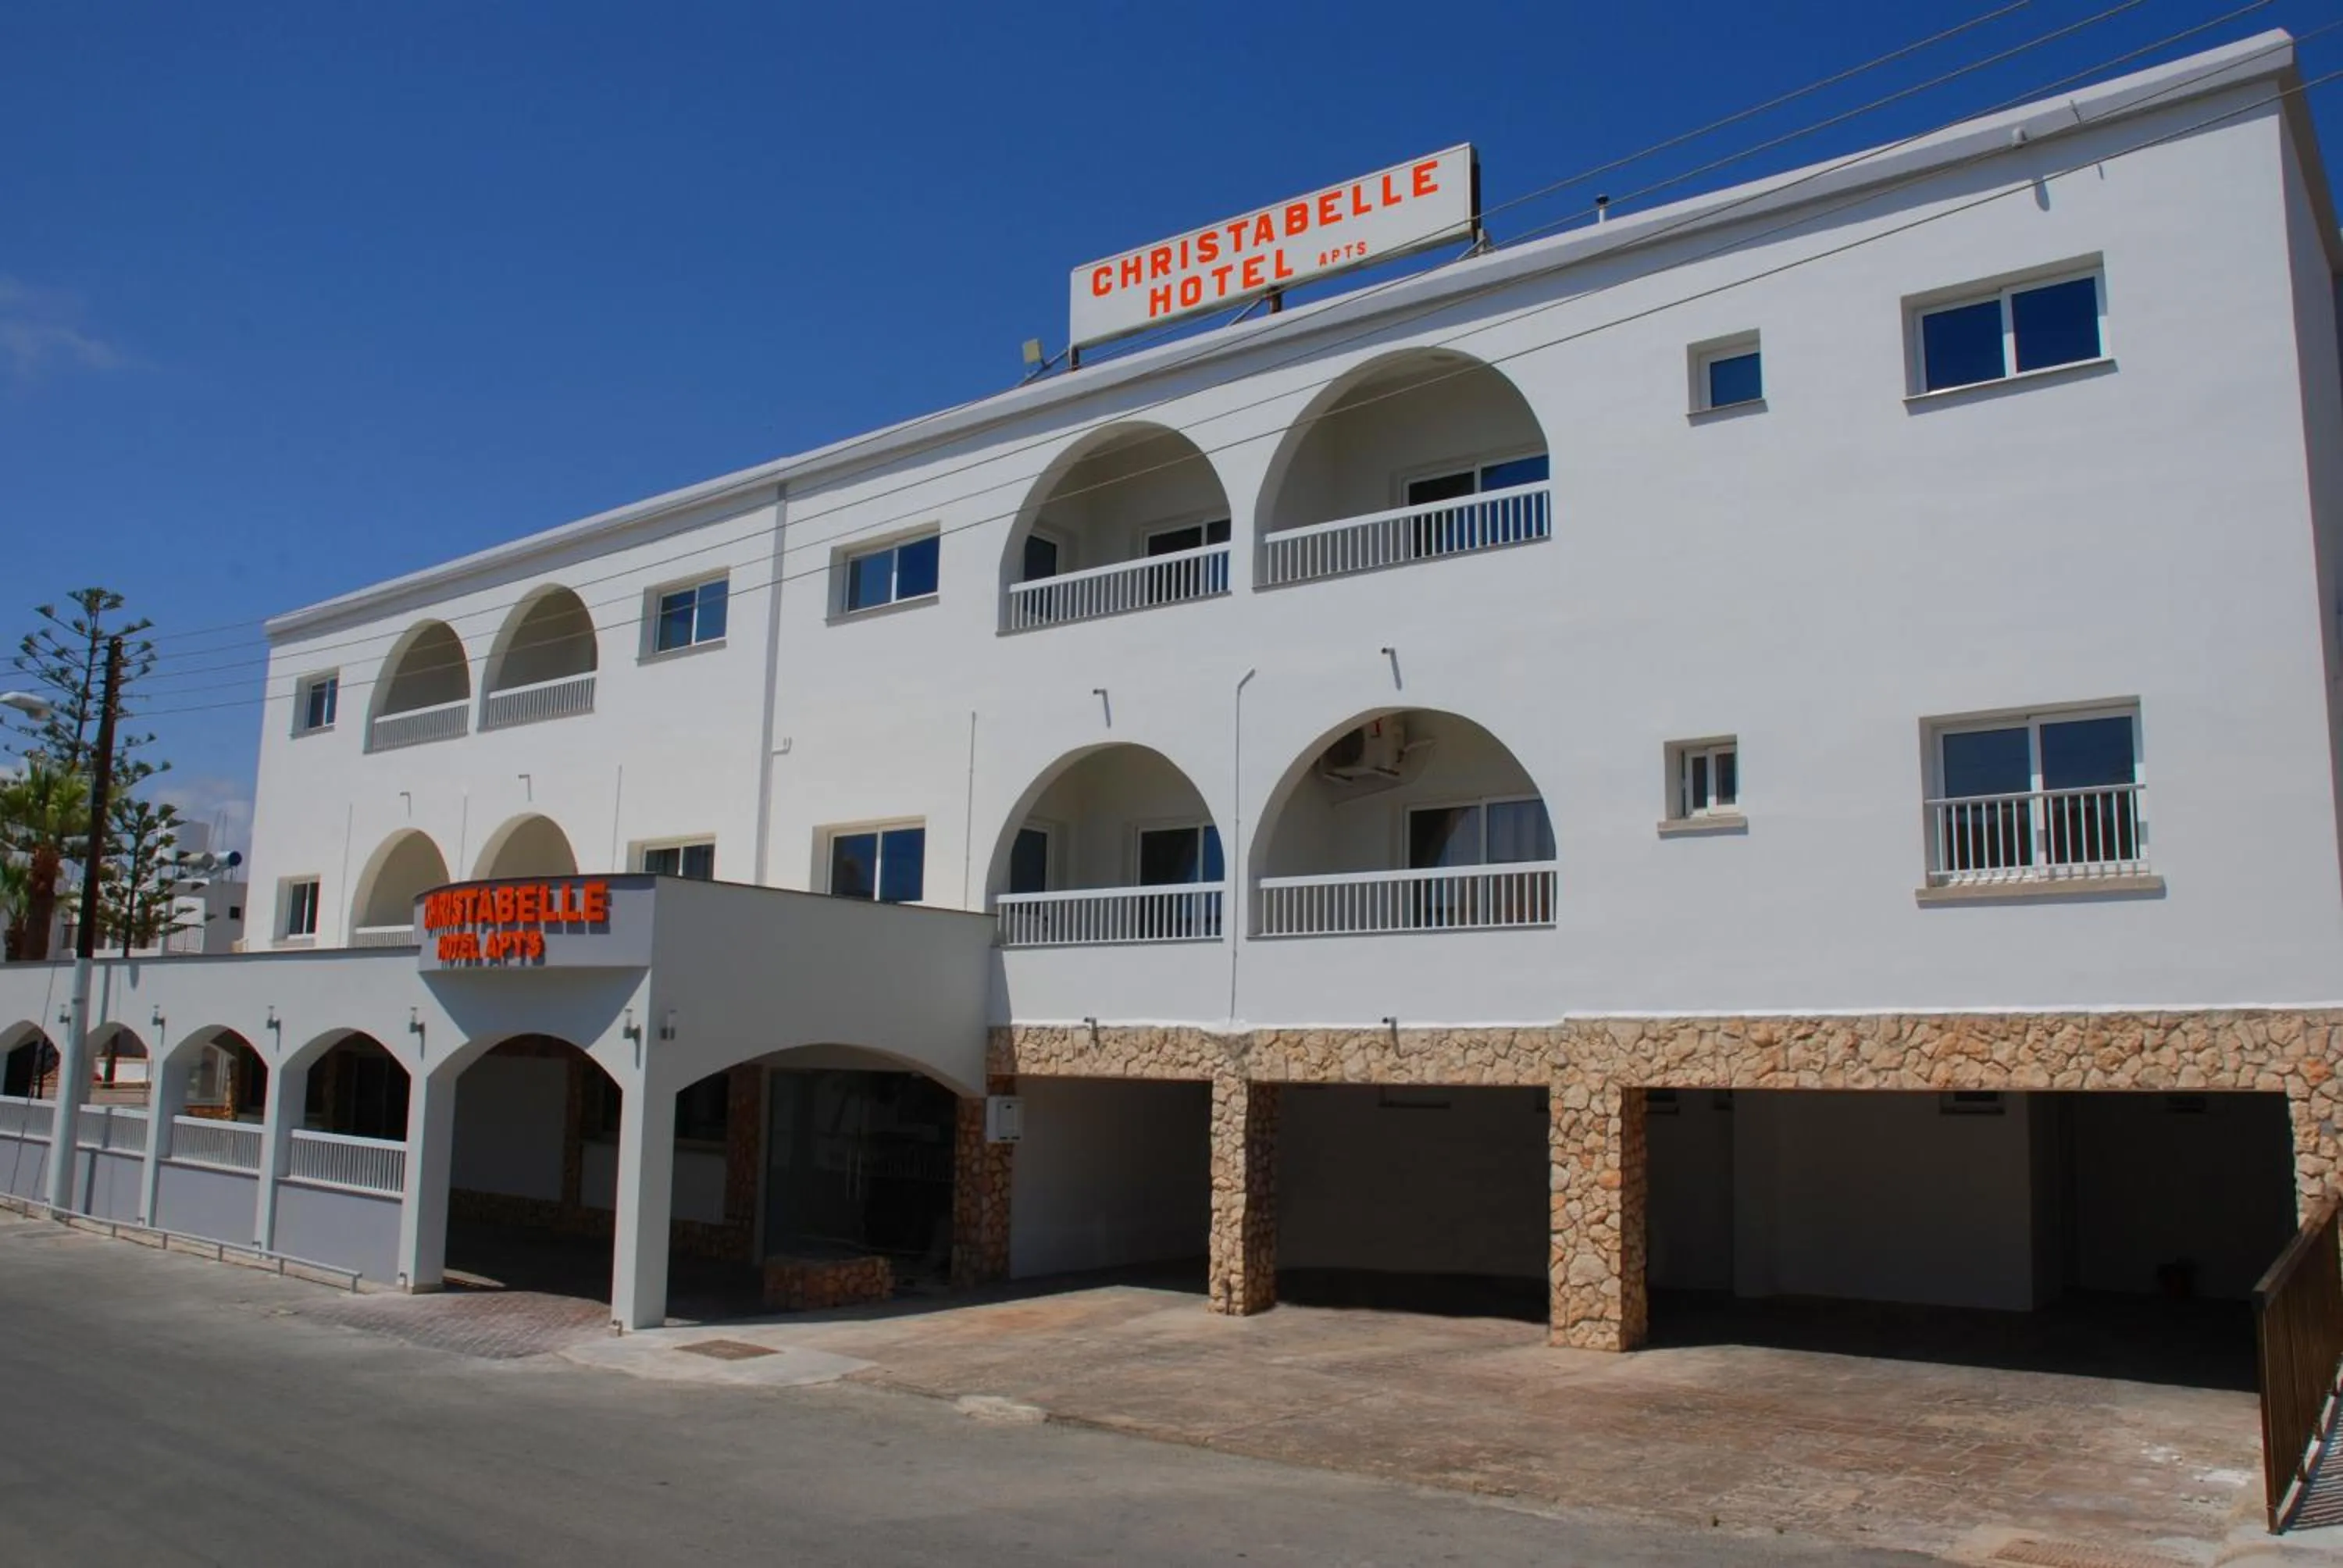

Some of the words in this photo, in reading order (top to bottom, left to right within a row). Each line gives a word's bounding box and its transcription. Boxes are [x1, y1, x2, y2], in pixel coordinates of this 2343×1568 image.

[1092, 159, 1439, 298] CHRISTABELLE
[1149, 248, 1294, 318] HOTEL
[1318, 241, 1367, 266] APTS
[437, 932, 480, 960] HOTEL
[486, 929, 543, 960] APTS
